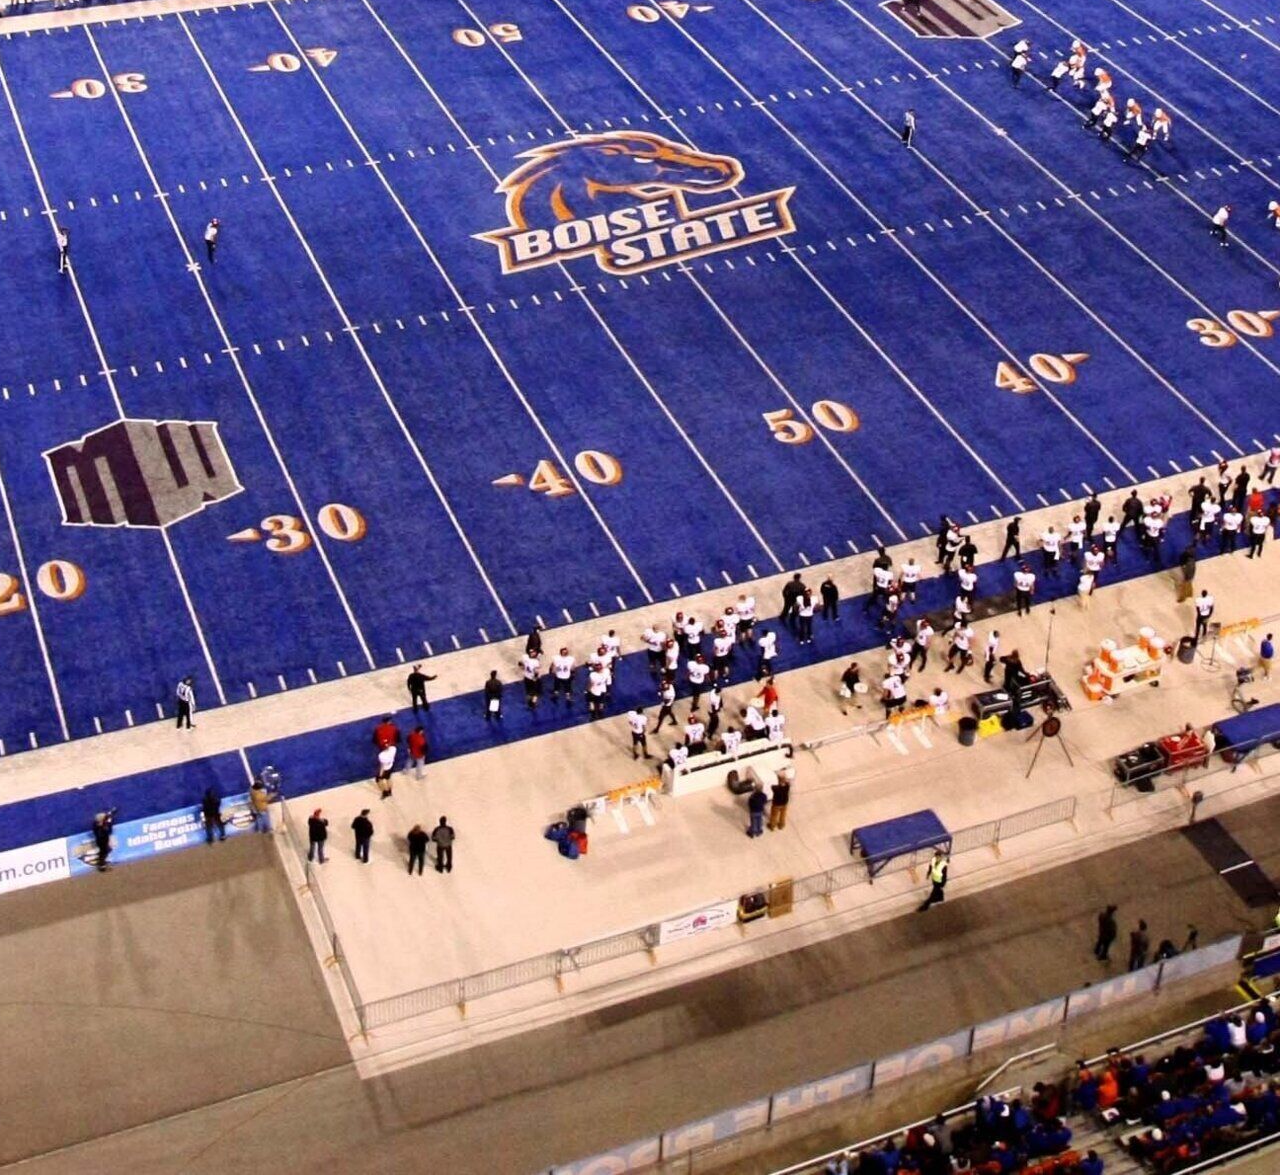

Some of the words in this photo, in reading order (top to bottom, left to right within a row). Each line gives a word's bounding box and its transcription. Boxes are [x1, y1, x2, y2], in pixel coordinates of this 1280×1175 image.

[626, 0, 692, 23] 40
[453, 23, 524, 50] 50
[267, 47, 337, 75] 40
[68, 72, 148, 102] 30
[511, 198, 676, 262] BOISE
[611, 202, 778, 267] STATE
[1185, 308, 1275, 348] 30
[992, 351, 1078, 395] 40
[761, 398, 861, 445] 50
[524, 449, 622, 499] 40
[260, 502, 367, 556] 30
[127, 829, 167, 848] Idaho
[142, 813, 195, 834] Famous
[154, 834, 189, 851] Bowl
